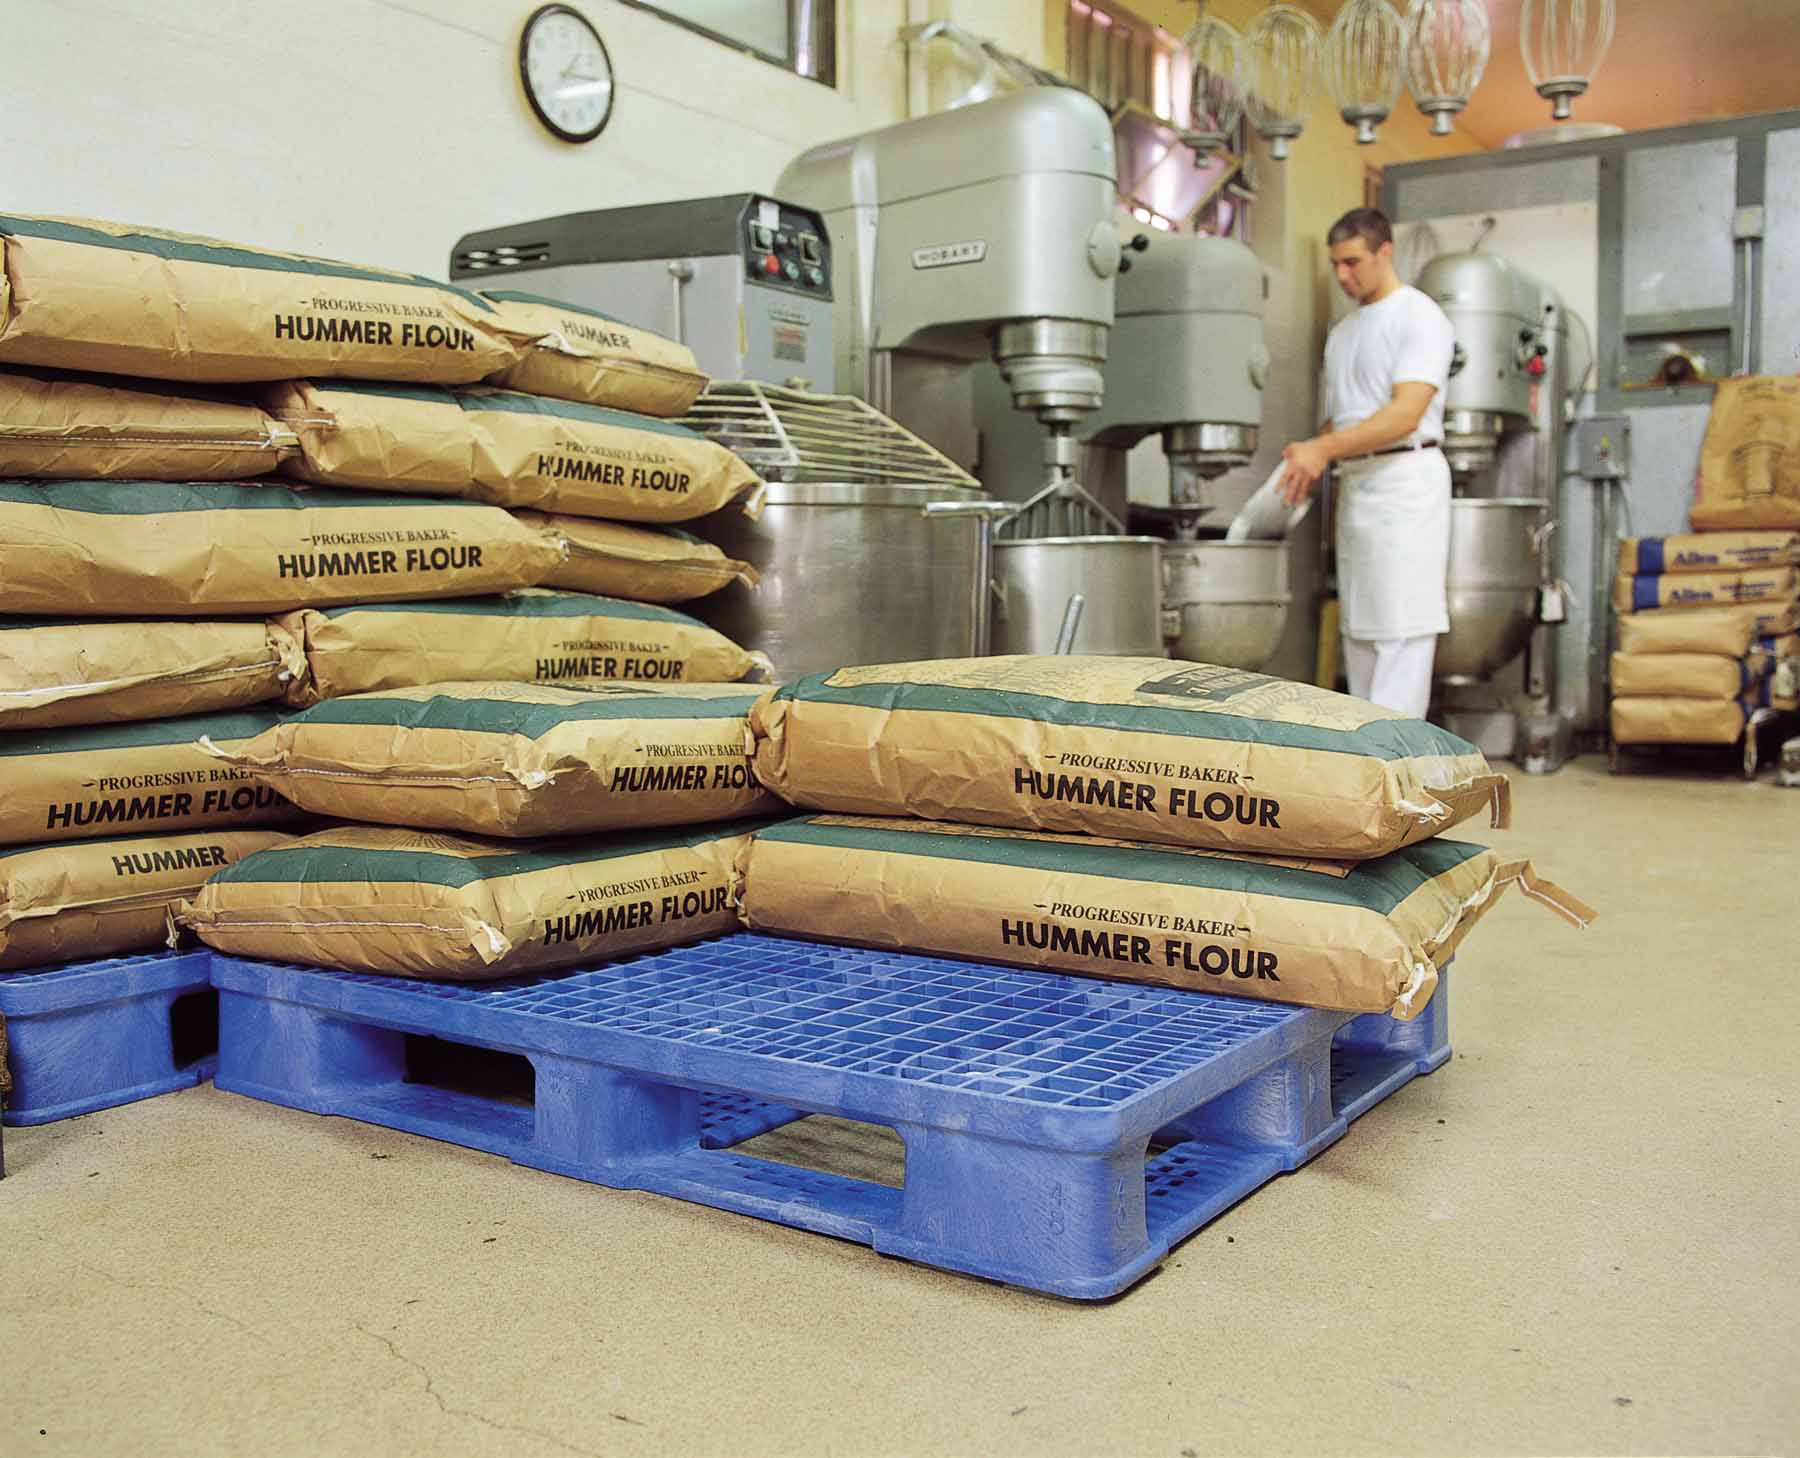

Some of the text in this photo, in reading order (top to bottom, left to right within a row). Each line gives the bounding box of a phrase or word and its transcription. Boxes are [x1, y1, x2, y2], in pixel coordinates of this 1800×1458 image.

[312, 297, 445, 319] PROGRESSIVE BAKER
[275, 314, 475, 352] HUMMER FLOUR
[561, 320, 632, 350] HUMMER
[537, 455, 690, 494] HUMMER FLOUR
[312, 528, 450, 547] PROGRESSIVE BAKER
[278, 545, 483, 579] HUMMER FLOUR
[623, 657, 684, 680] FLOUR
[646, 743, 716, 758] PROGRESSIVE
[99, 770, 206, 792] PROGRESSIVE
[610, 763, 762, 792] HUMMER FLOU
[1060, 751, 1239, 785] PROGRESSIVE BAKER
[47, 791, 193, 830] HUMMER
[1014, 767, 1281, 829] HUMMER FLOUR
[111, 845, 230, 877] HUMMER
[578, 870, 701, 903] PROGRESSIVE BAKER
[543, 886, 728, 946] HUMMER FLOUR
[1050, 902, 1236, 938] PROGRESSIVE BAKER
[1001, 918, 1281, 982] HUMMER FLOUR
